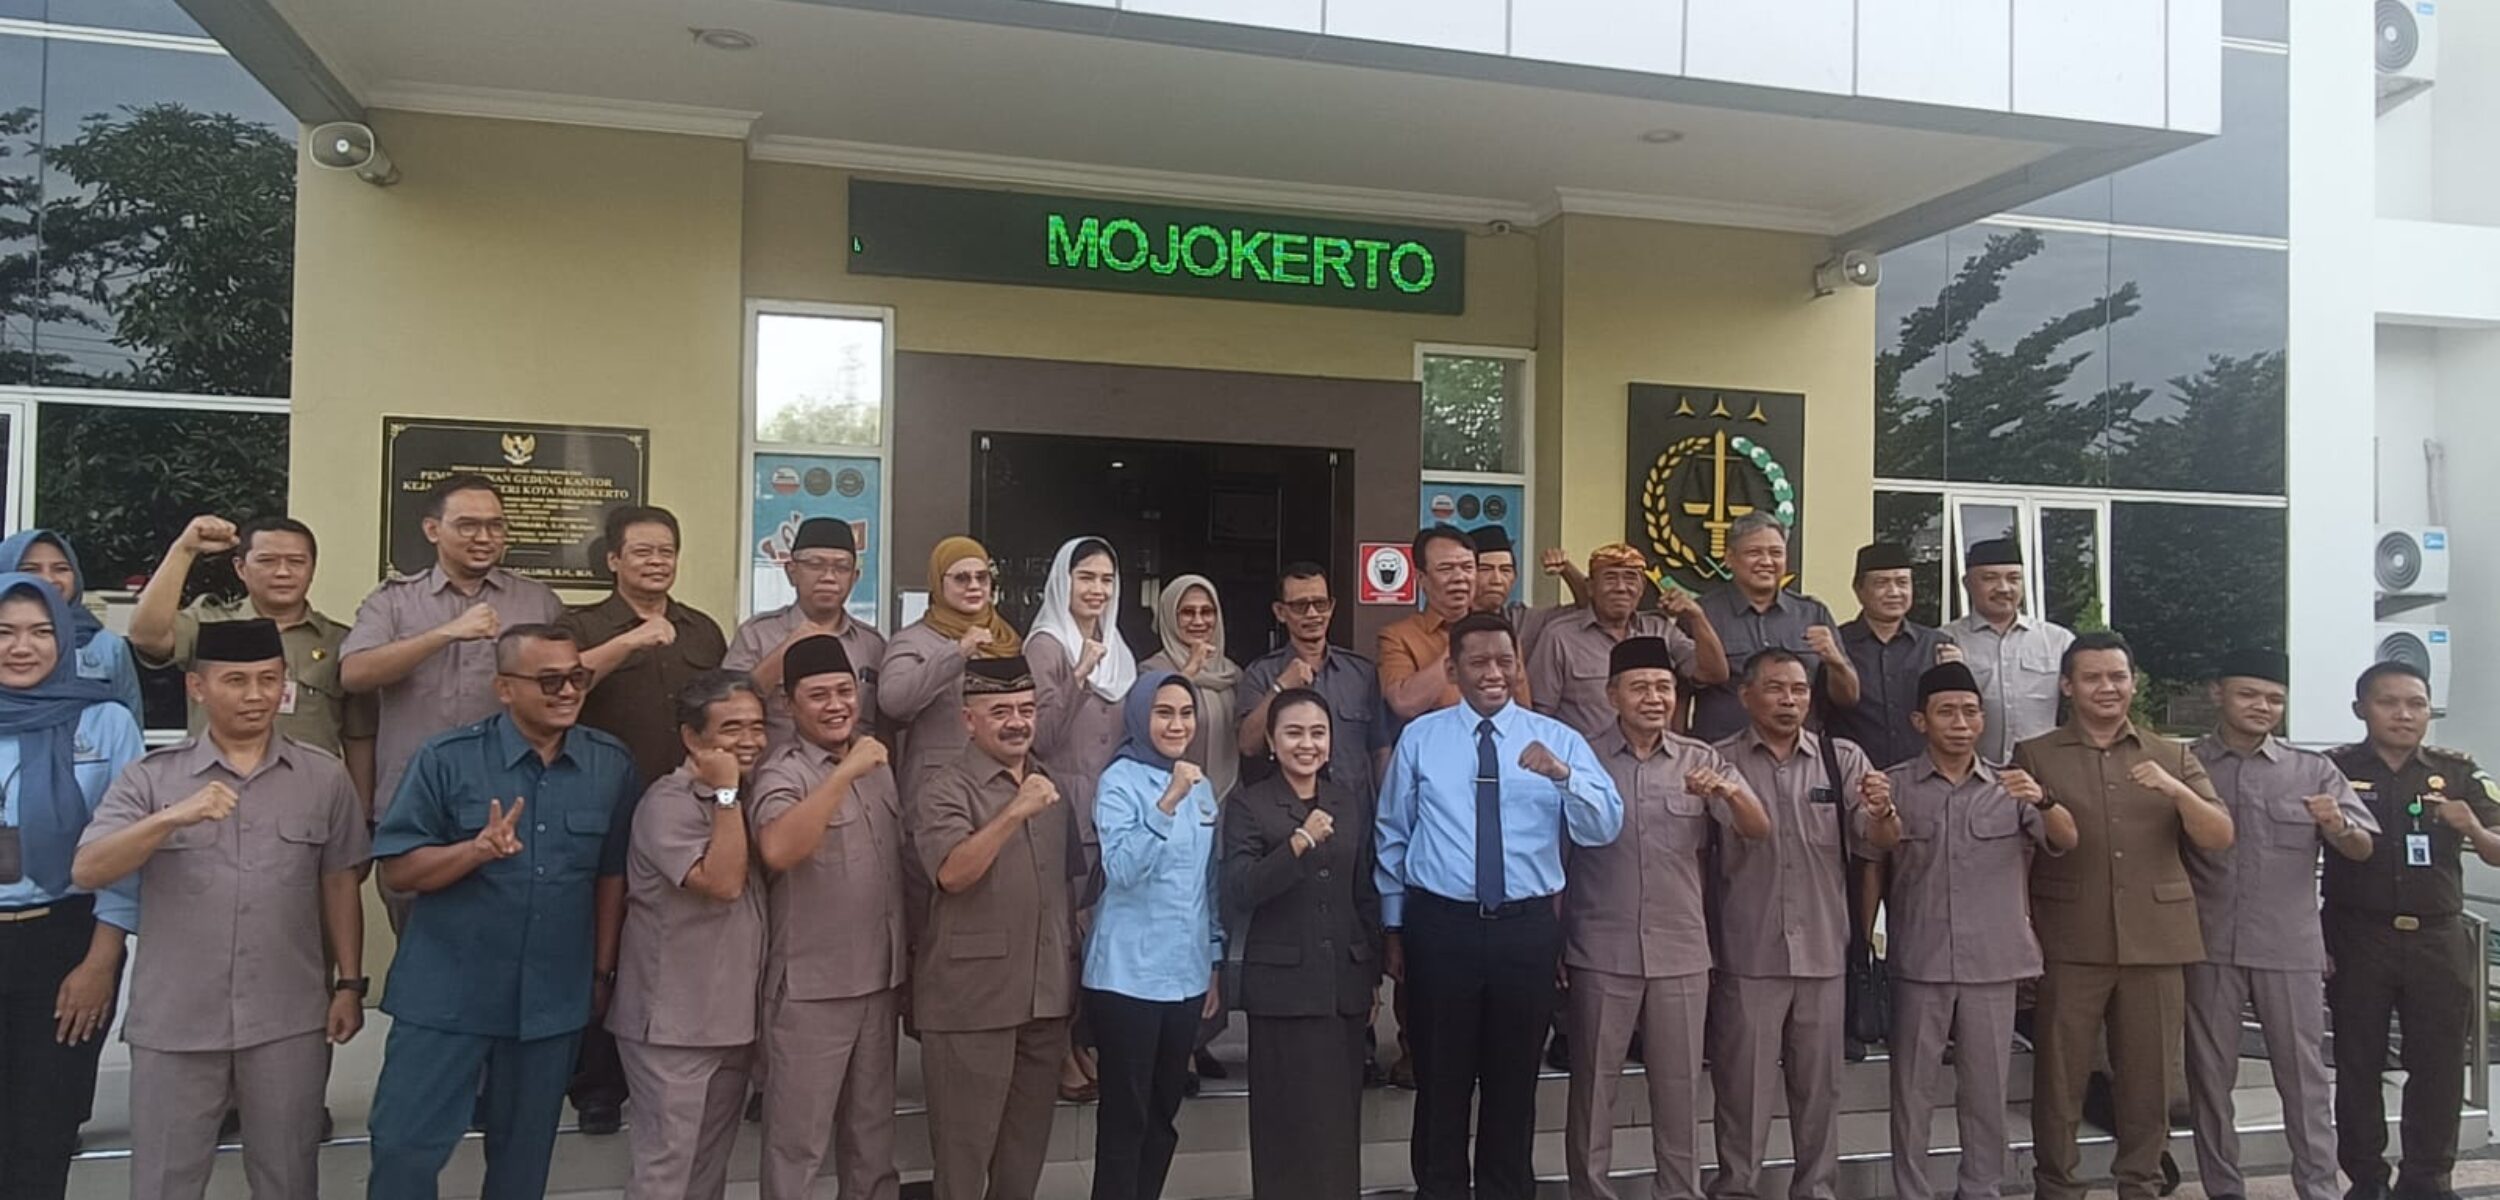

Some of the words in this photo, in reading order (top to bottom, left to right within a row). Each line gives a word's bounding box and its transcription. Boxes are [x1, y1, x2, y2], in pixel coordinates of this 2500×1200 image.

[1047, 214, 1435, 293] MOJOKERTO
[513, 474, 561, 487] GEDUNG
[564, 476, 613, 488] KANTOR
[522, 485, 554, 497] KOTA
[556, 487, 629, 500] MOJOKERTO
